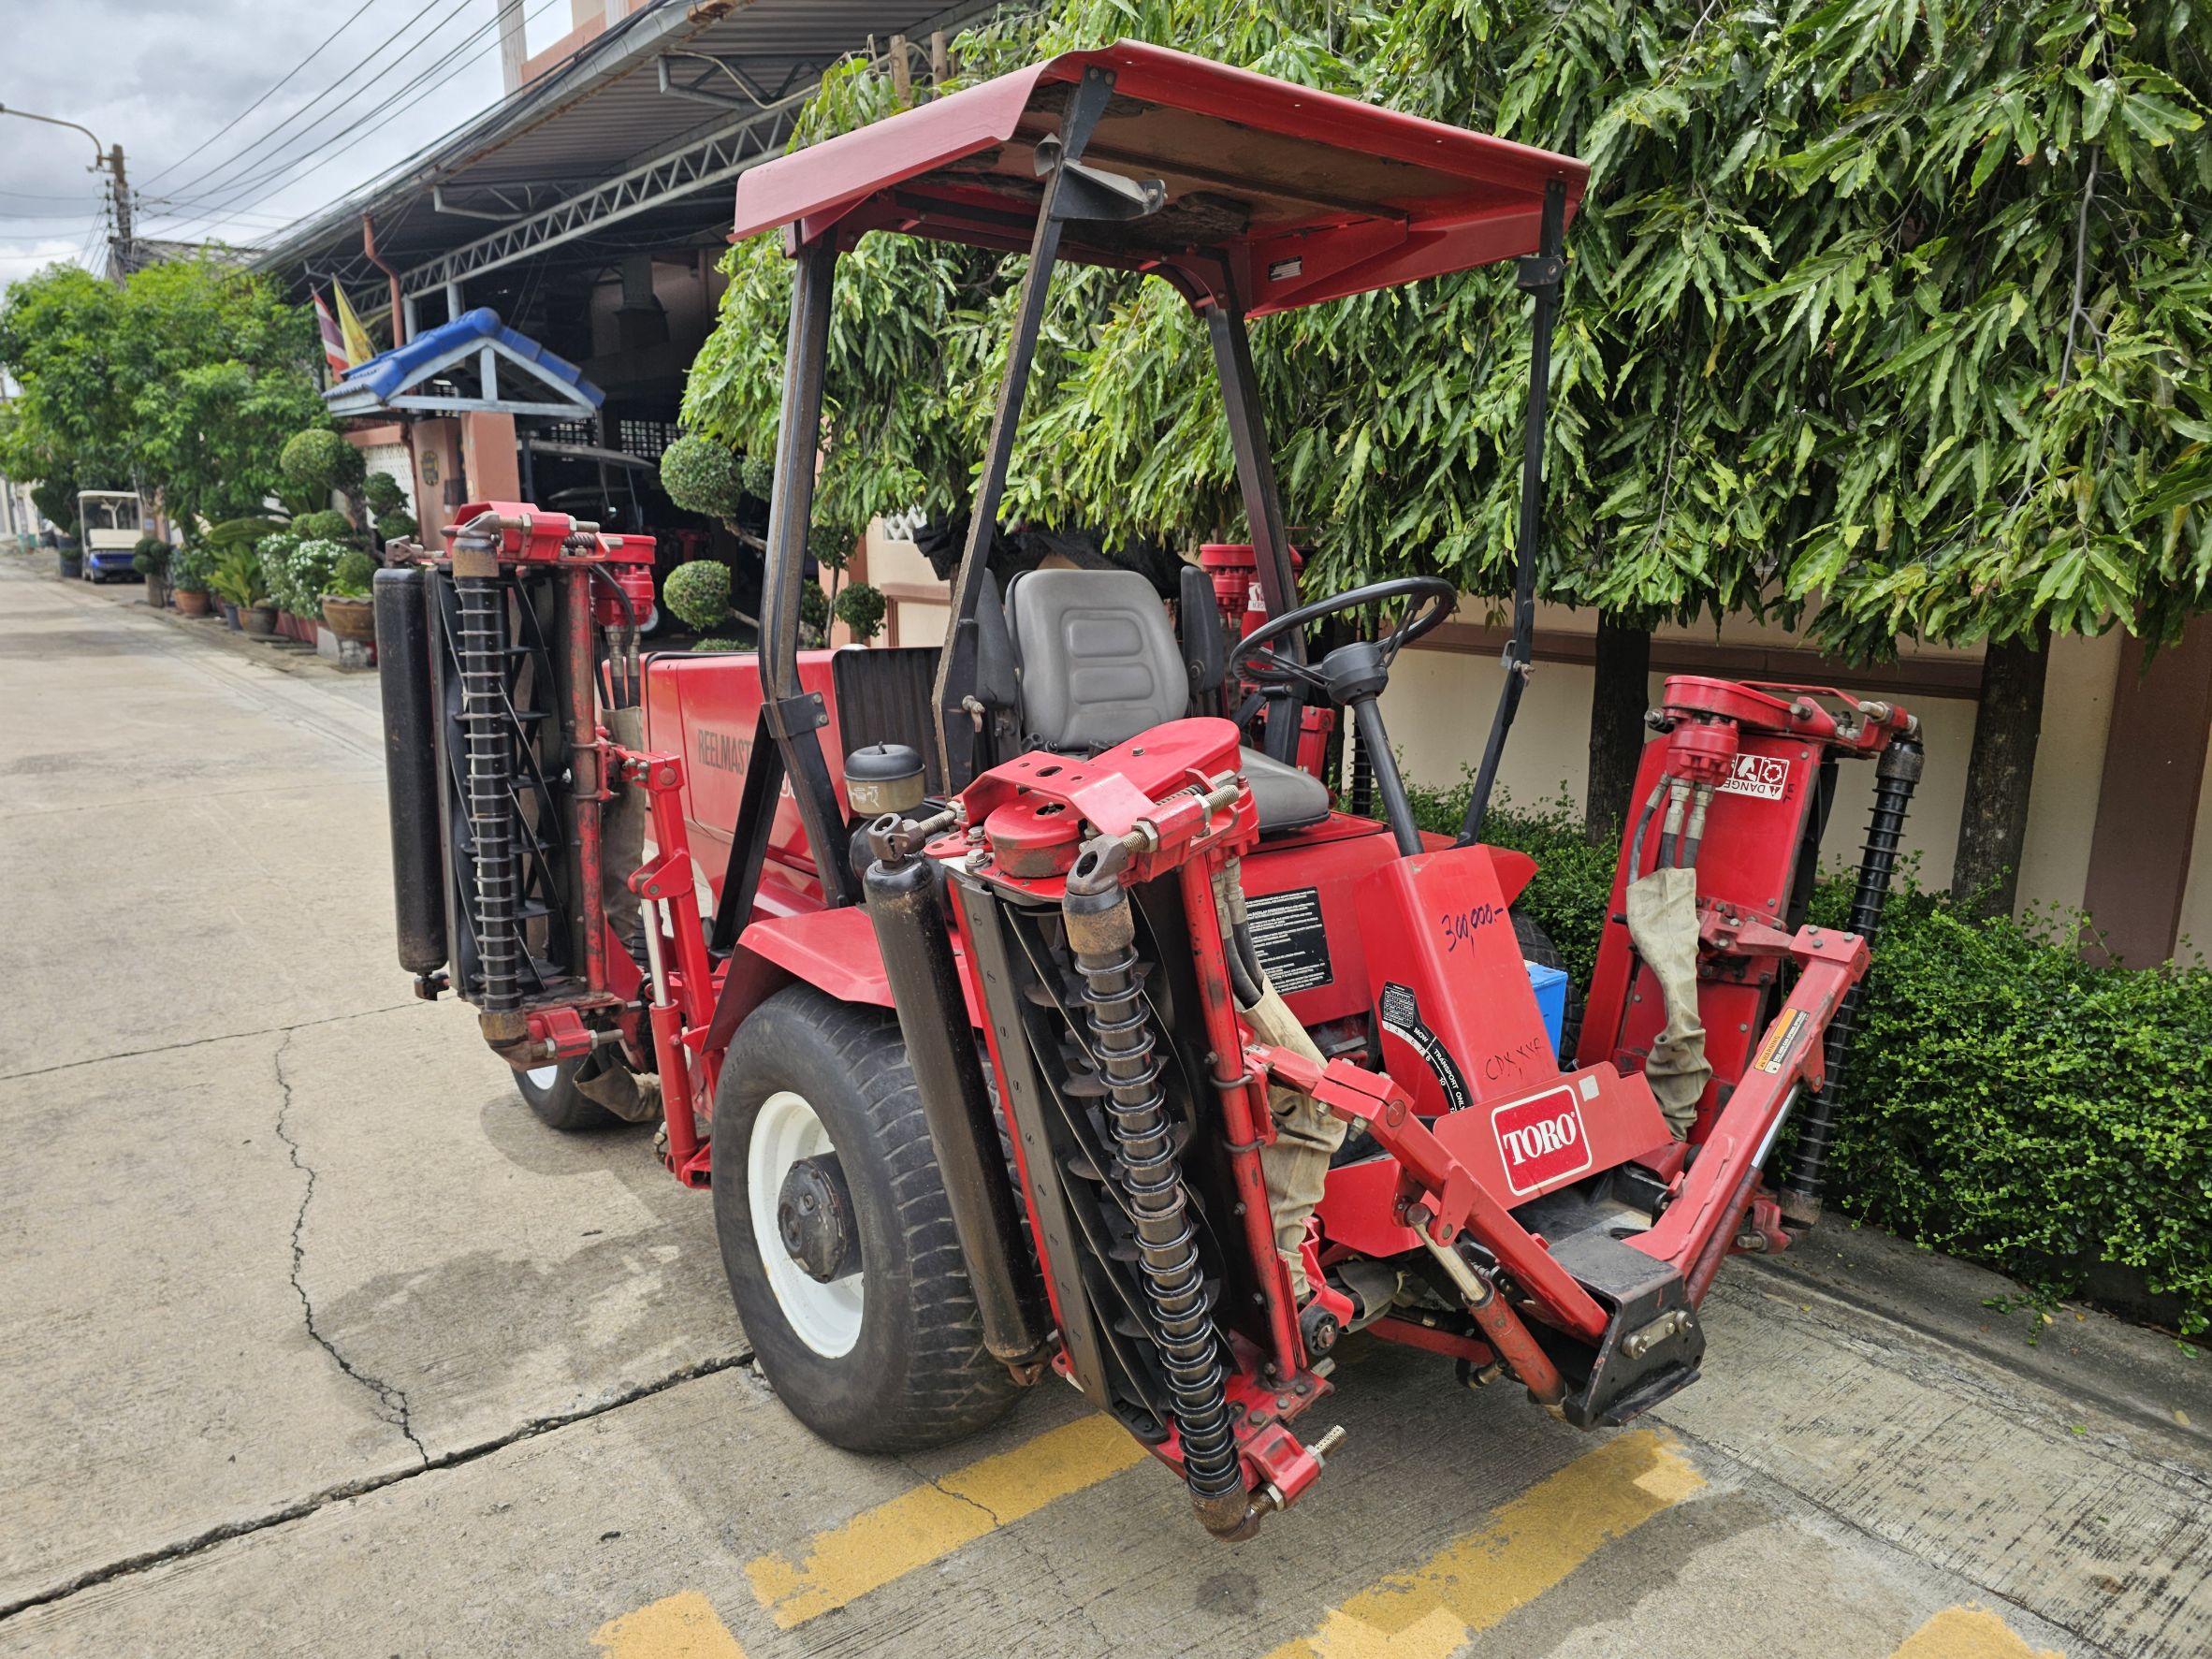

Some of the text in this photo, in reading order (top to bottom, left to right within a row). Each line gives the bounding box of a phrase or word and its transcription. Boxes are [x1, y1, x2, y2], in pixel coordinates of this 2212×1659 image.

[698, 728, 751, 776] REELMAST
[1724, 779, 1766, 793] DANGE
[1413, 1026, 1429, 1042] MOW
[1764, 1035, 1781, 1061] WARNING
[1433, 1048, 1460, 1089] TRANSPORT
[1439, 1076, 1446, 1086] 10
[1502, 1113, 1577, 1166] TORO
